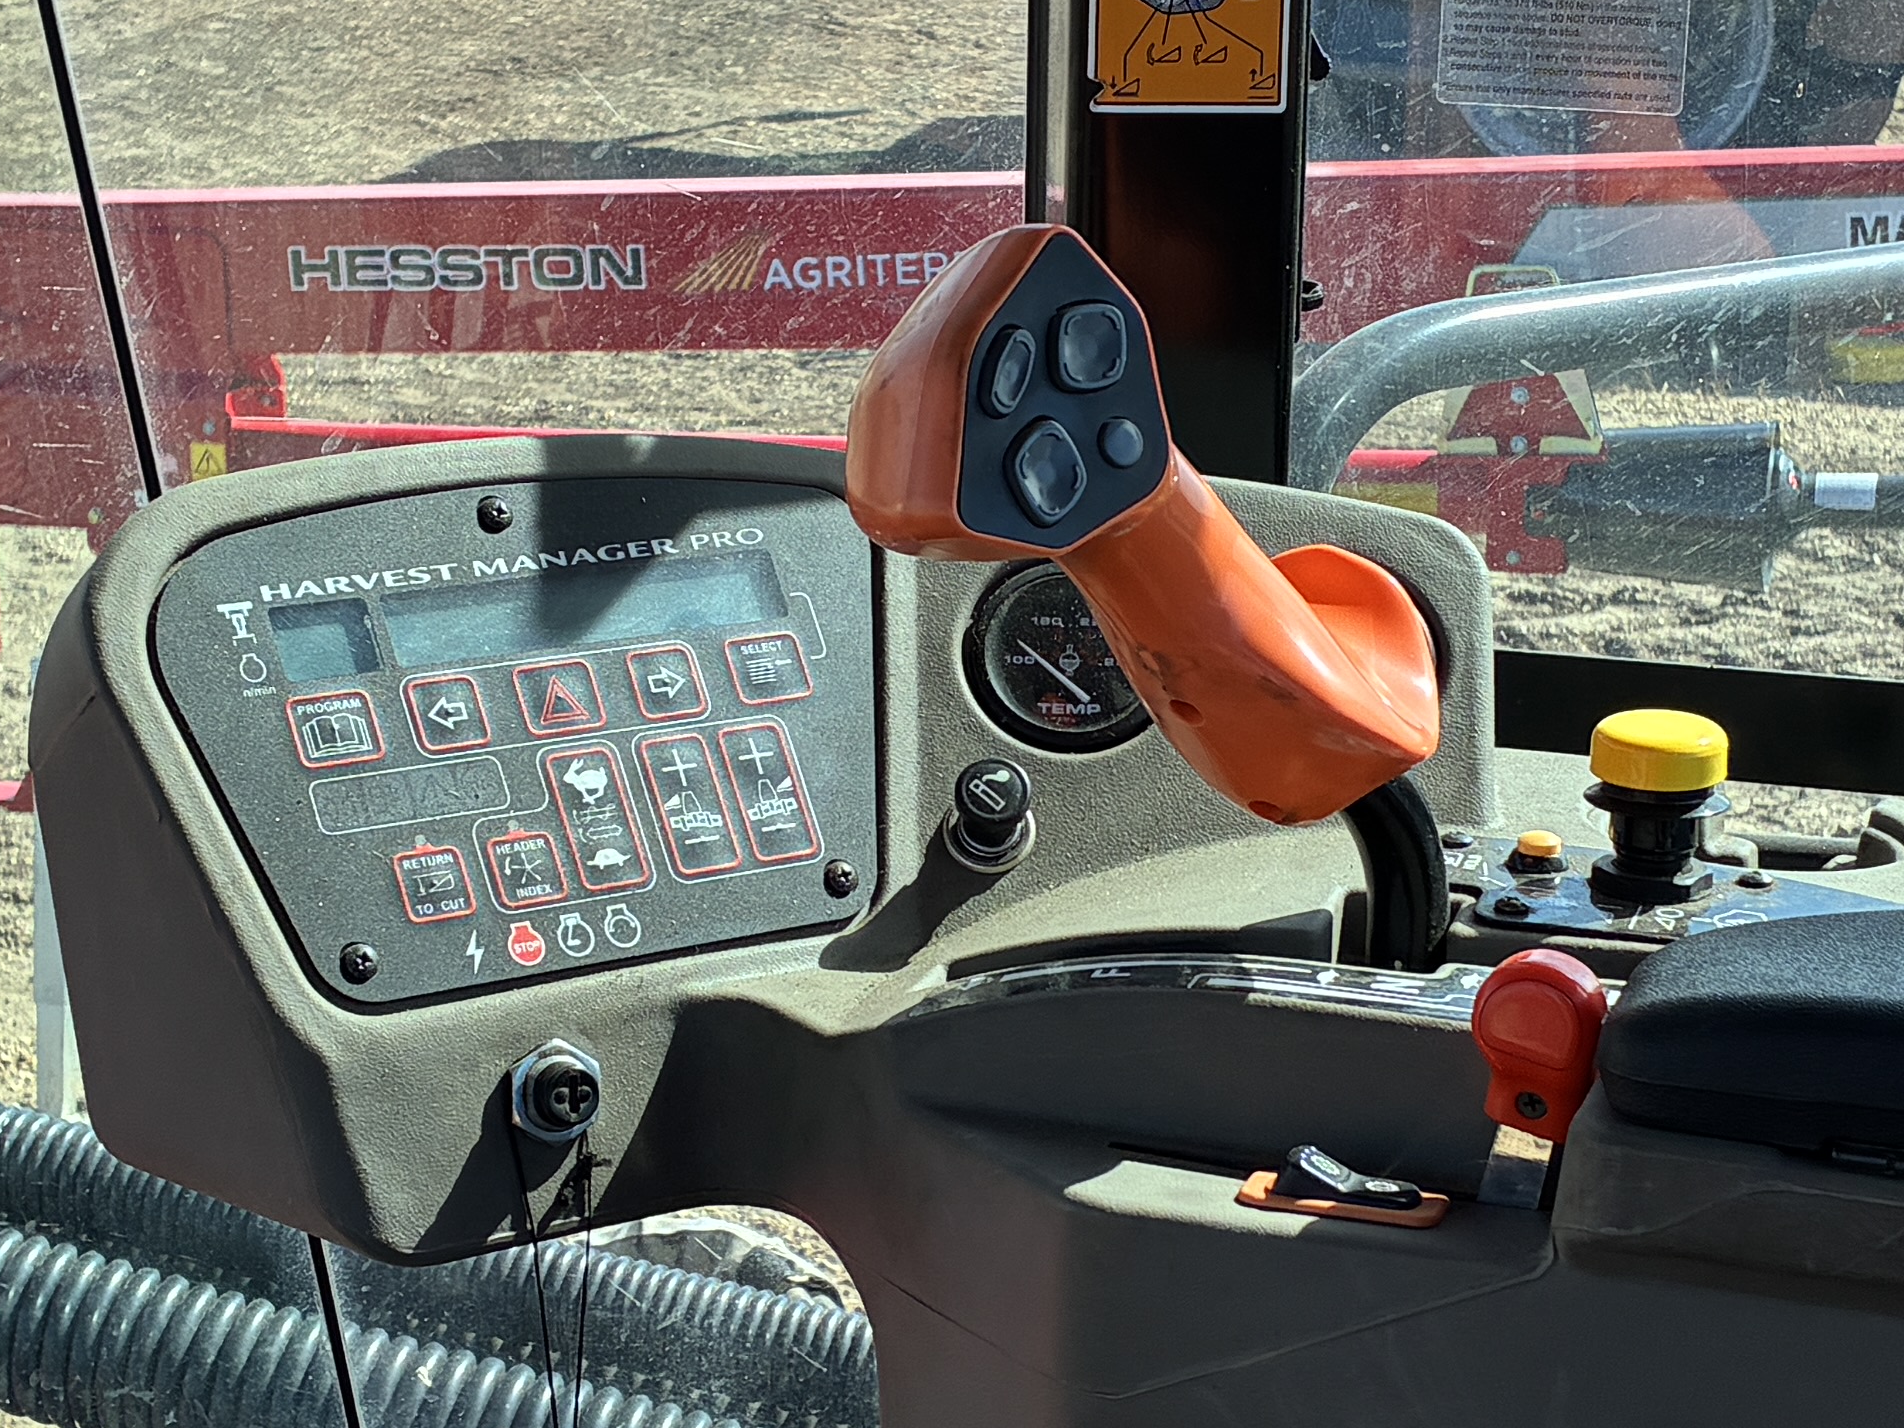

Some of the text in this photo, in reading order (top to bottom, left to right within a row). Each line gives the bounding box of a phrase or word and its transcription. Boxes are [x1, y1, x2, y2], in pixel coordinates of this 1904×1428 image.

[287, 244, 958, 292] HESSTON AGRITER
[259, 528, 764, 602] HARVEST MANAGER PRO
[740, 640, 783, 655] SELECT
[243, 685, 277, 698] n/min
[296, 698, 362, 716] PROGRAM
[1037, 702, 1101, 715] TEMP
[496, 838, 546, 856] HEADER
[402, 853, 454, 871] RETURN
[515, 883, 554, 899] INDEX
[415, 898, 466, 916] TO CUT
[513, 940, 541, 955] STOP
